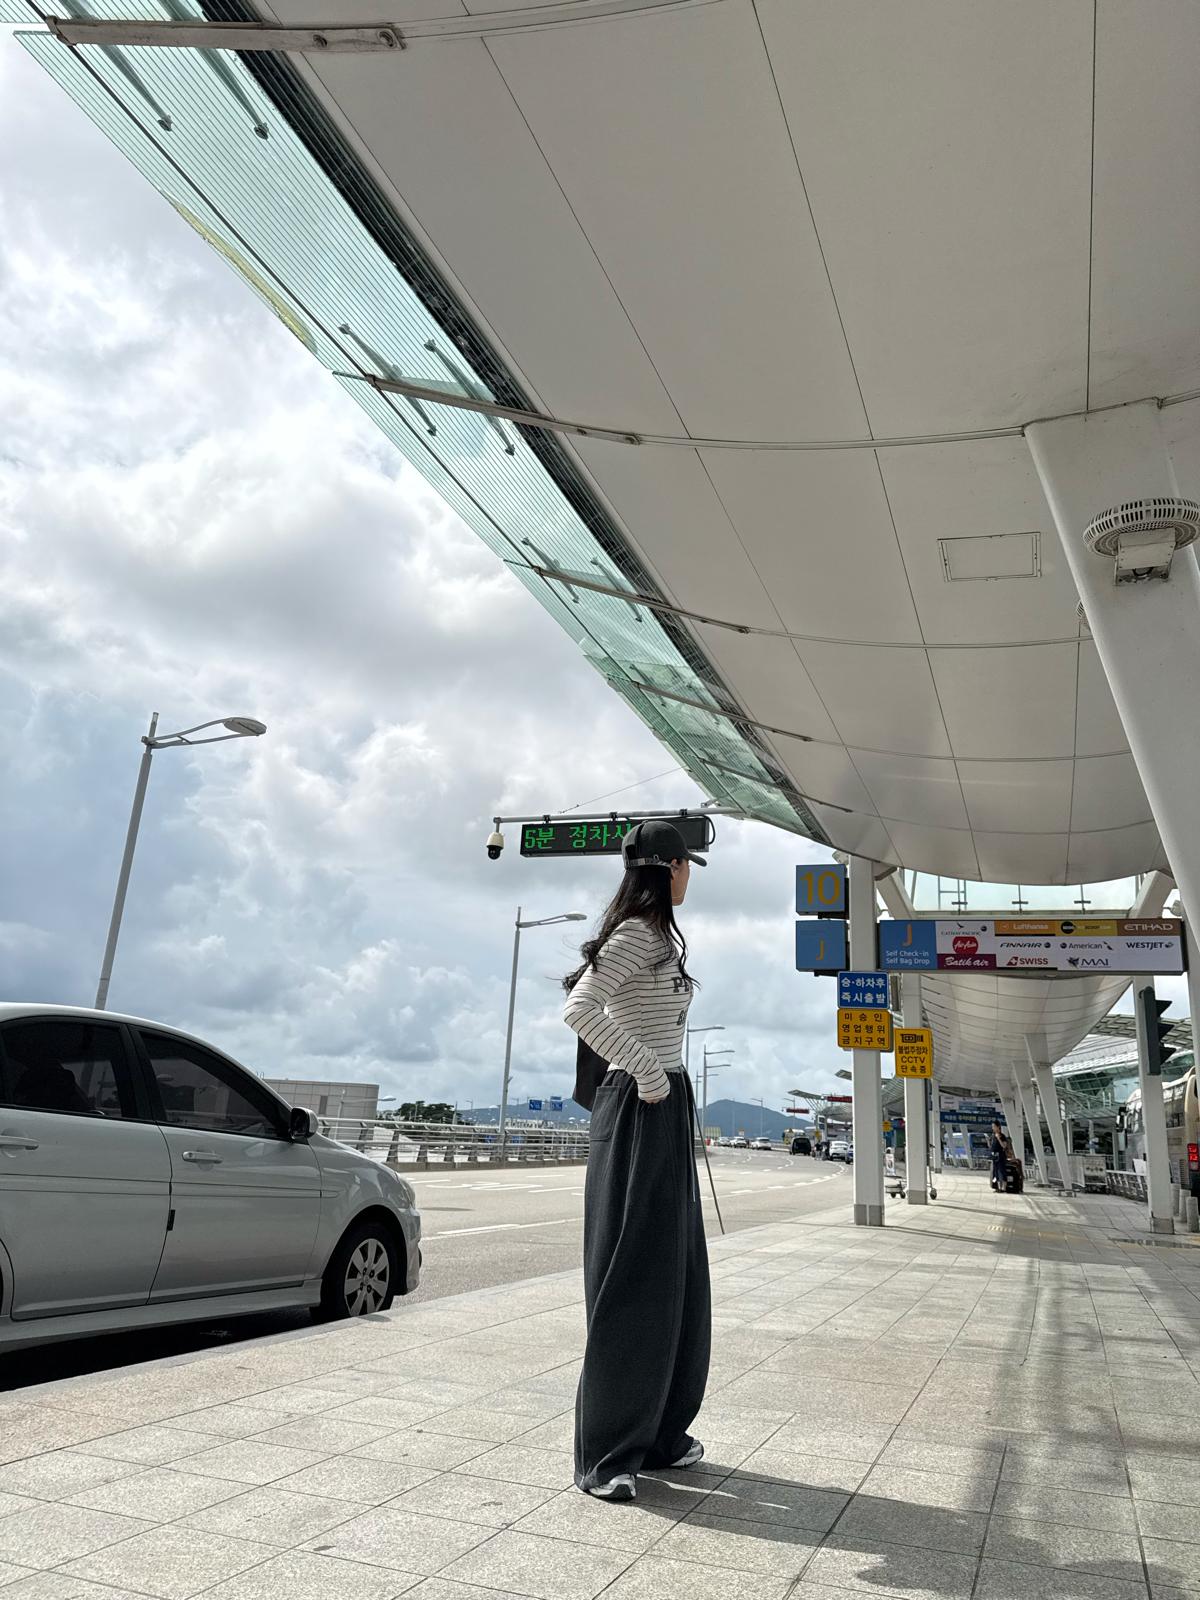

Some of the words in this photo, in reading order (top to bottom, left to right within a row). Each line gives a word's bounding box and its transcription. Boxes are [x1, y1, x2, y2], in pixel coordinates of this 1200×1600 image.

[524, 827, 556, 849] 5분
[800, 871, 840, 905] 10
[1124, 923, 1174, 931] ETIHAD
[902, 923, 913, 947] J
[815, 939, 825, 961] J
[1126, 942, 1164, 950] WESTJET
[899, 958, 913, 966] Bag
[913, 958, 930, 966] Drop
[944, 956, 972, 967] Batik
[972, 959, 989, 967] air
[1020, 957, 1049, 965] SWISS
[1080, 958, 1109, 966] MAI
[841, 992, 886, 1004] 즉시출발
[901, 1055, 926, 1064] CCTV
